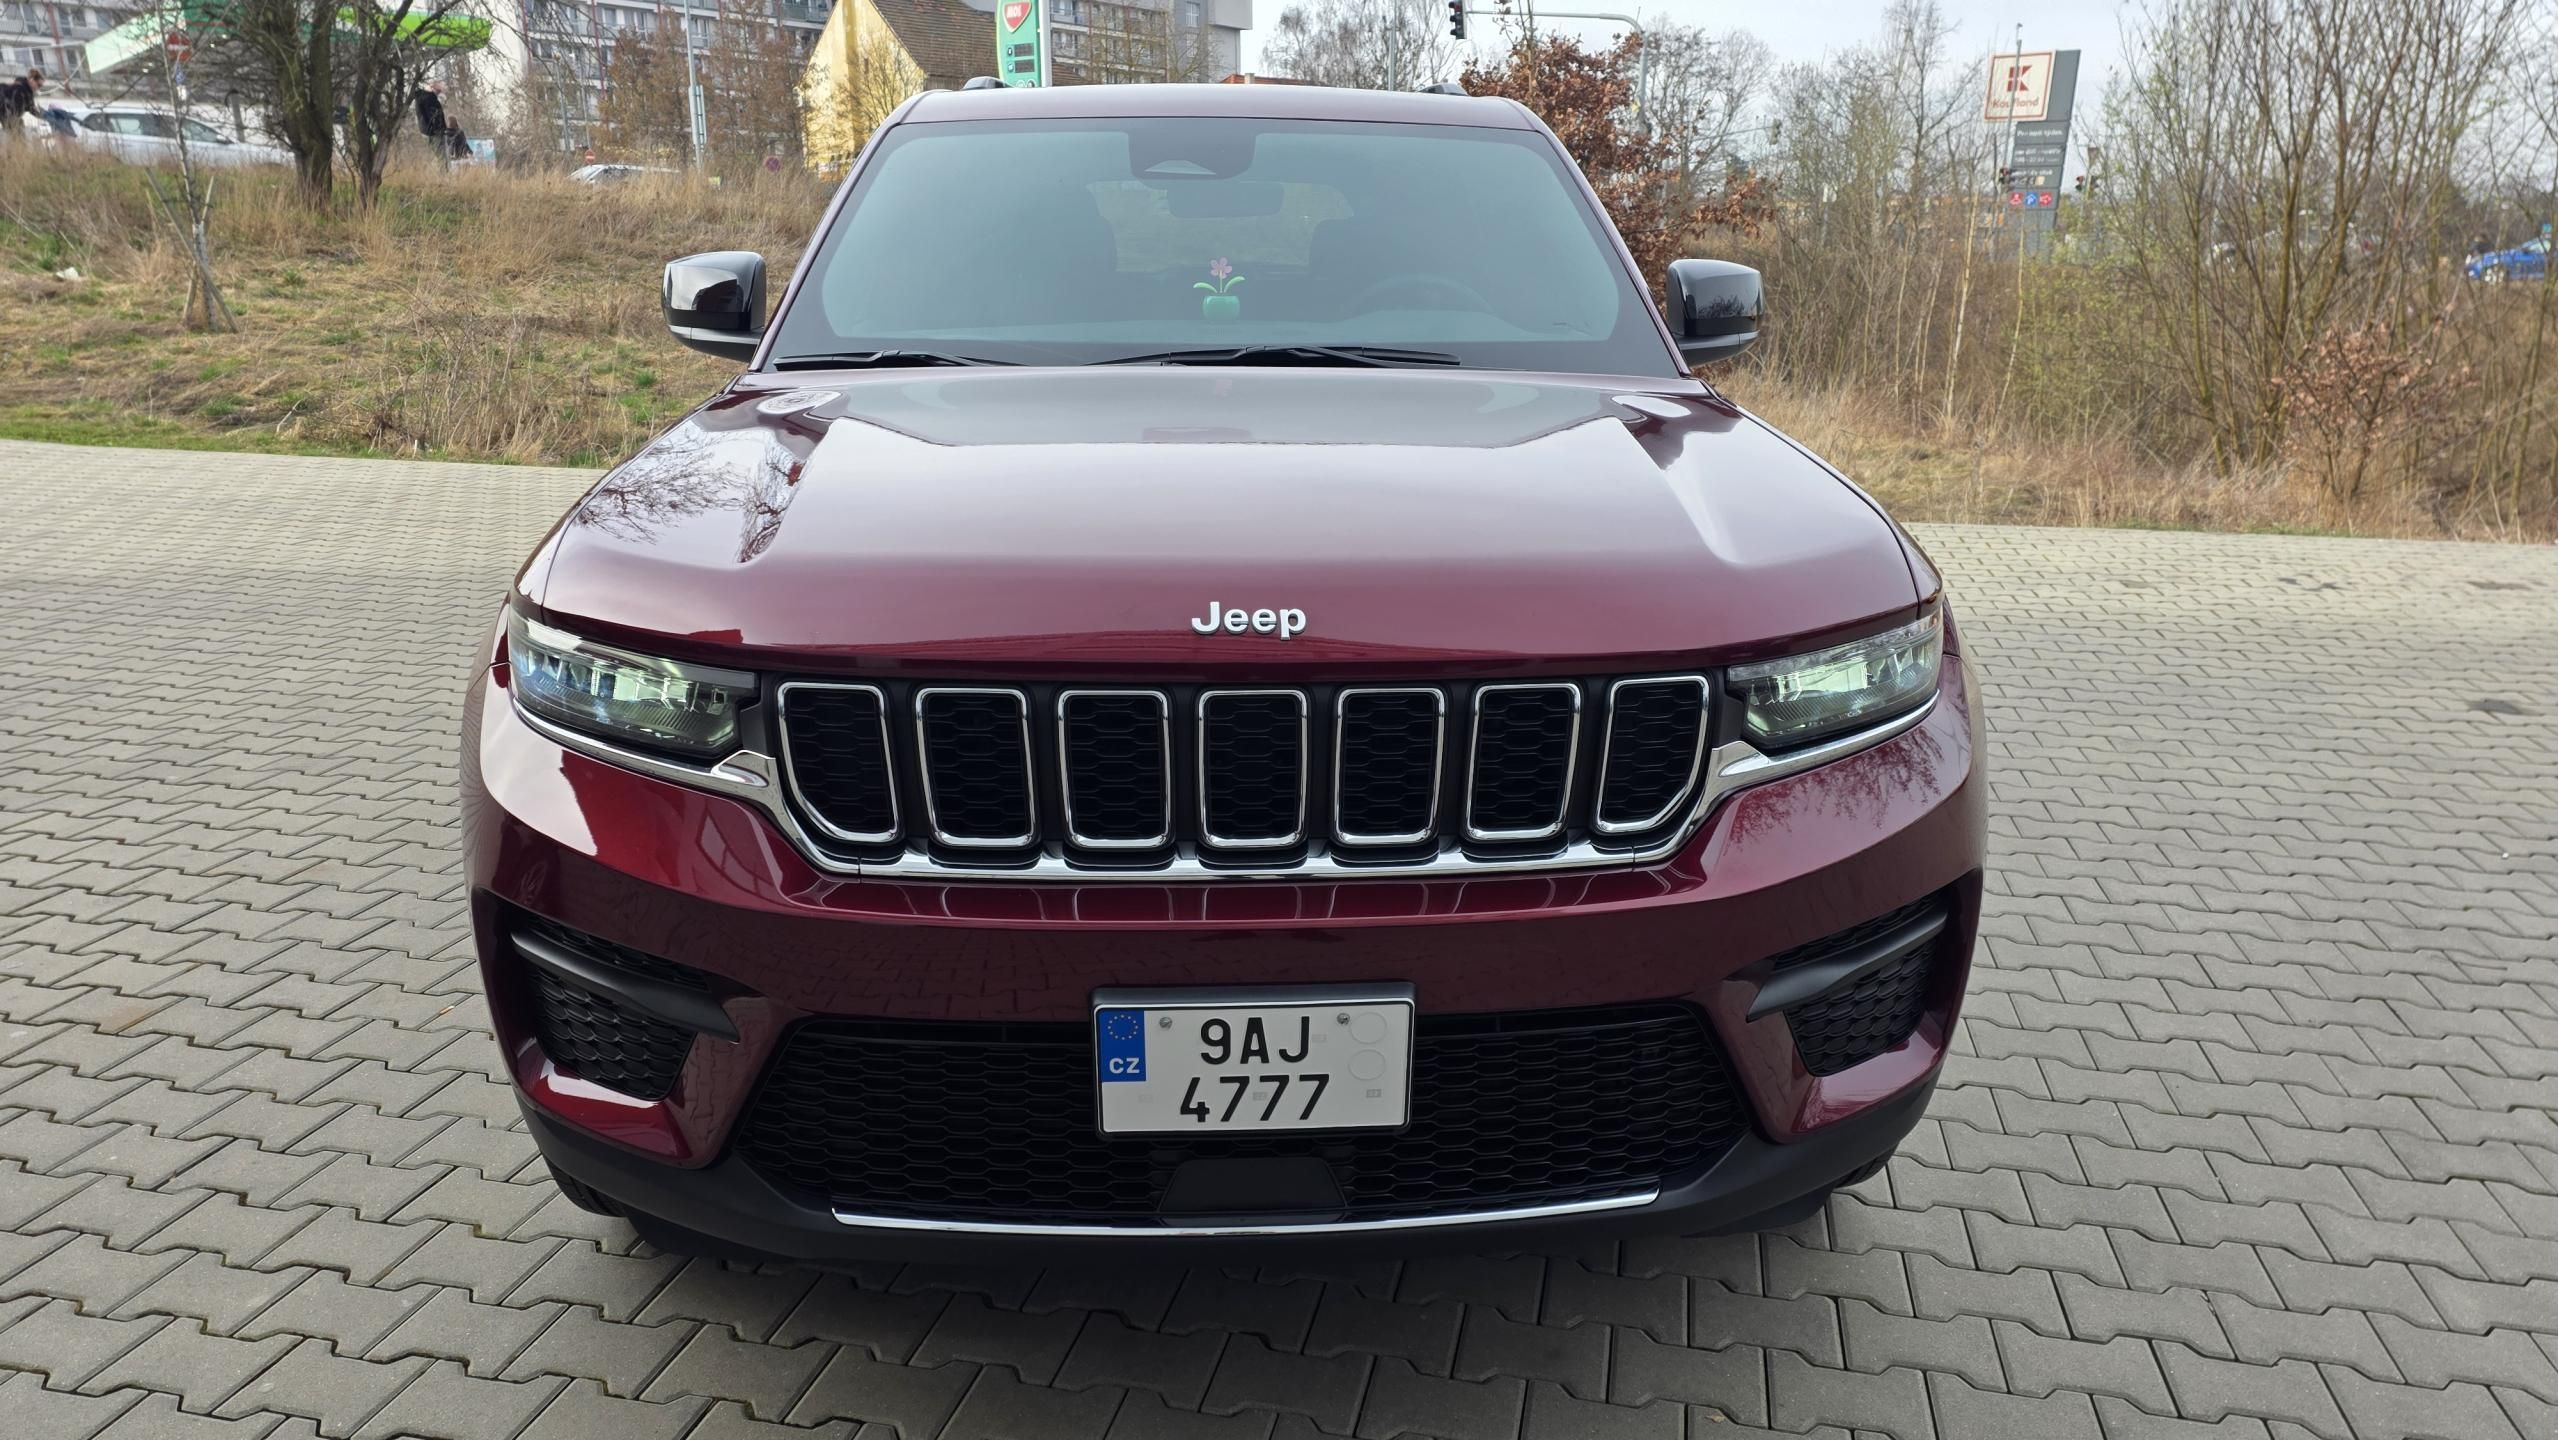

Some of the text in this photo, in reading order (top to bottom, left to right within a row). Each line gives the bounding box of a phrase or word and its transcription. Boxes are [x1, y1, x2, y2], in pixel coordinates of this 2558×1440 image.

[1992, 96, 2040, 108] Kaland
[1191, 601, 1307, 640] Jeep
[1200, 1016, 1310, 1065] 9AJ
[1109, 1057, 1140, 1075] CZ
[1180, 1073, 1330, 1123] 4777
